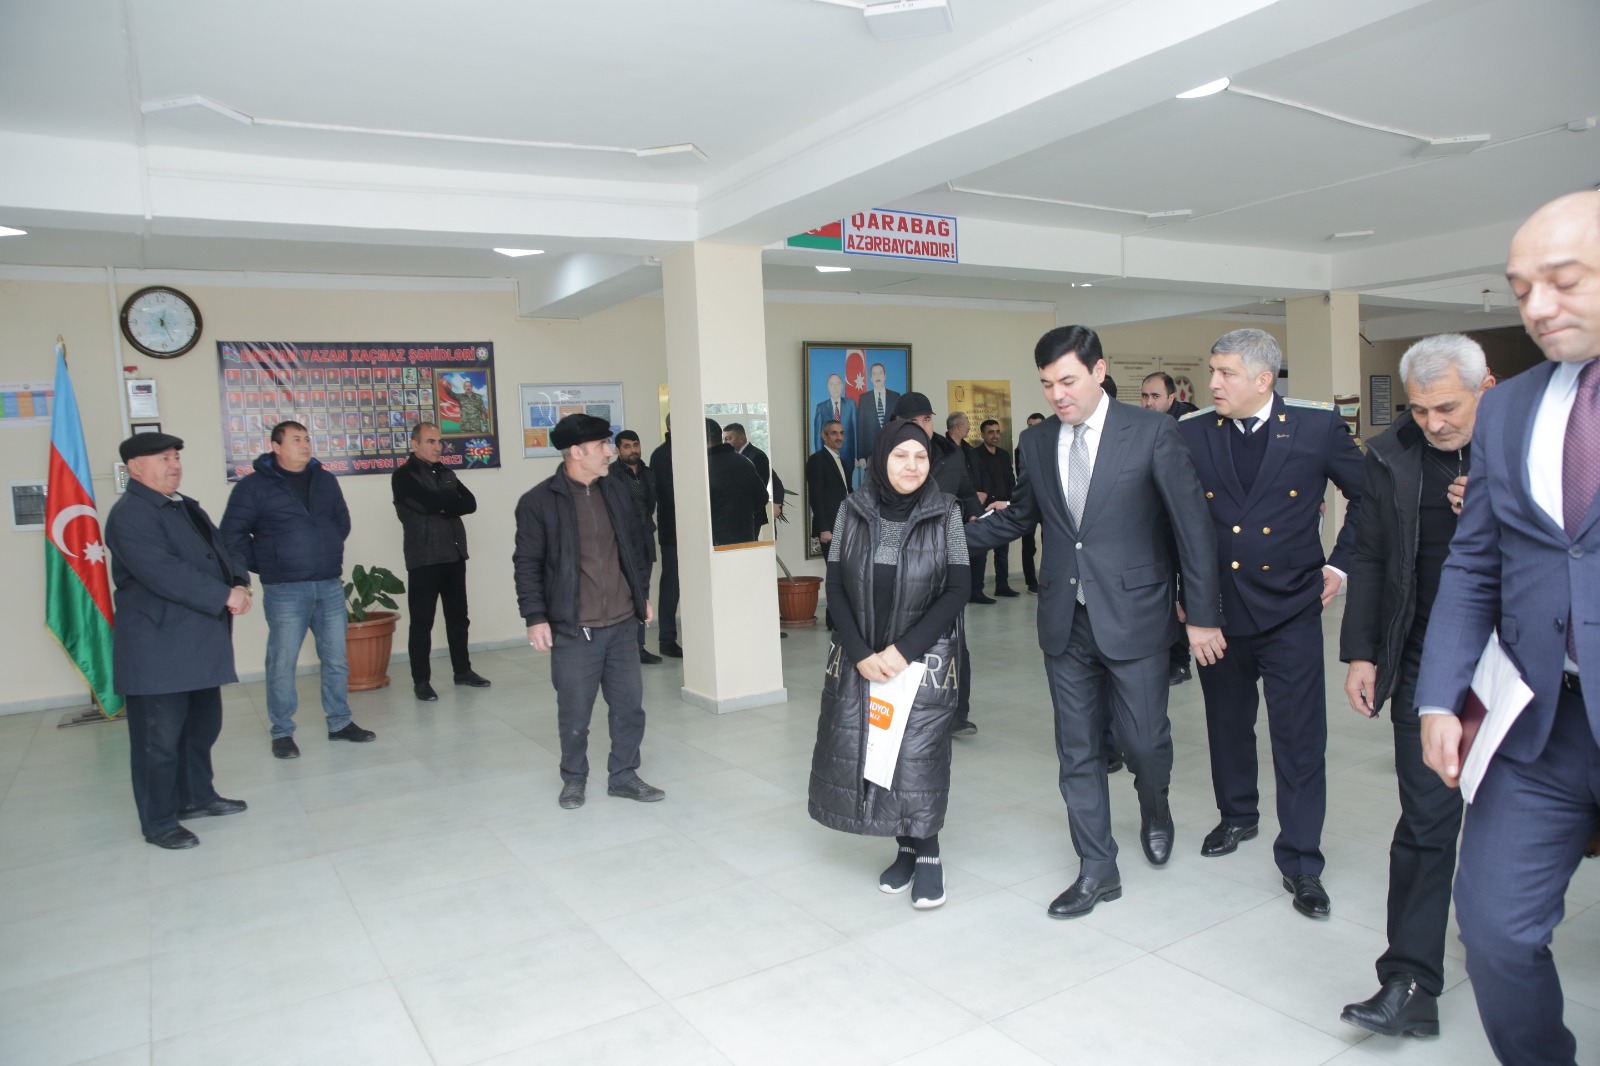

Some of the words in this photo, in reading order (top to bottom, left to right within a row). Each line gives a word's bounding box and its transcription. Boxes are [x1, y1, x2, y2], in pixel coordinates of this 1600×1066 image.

[852, 212, 950, 237] QARABAĞ
[847, 234, 955, 259] AZƏRBAYCANDIR!
[241, 349, 298, 363] DASTAN
[301, 349, 348, 363] YAZAN
[350, 348, 406, 364] XAÇMAZ
[408, 346, 476, 364] ŞƏHİDLƏRİ
[352, 458, 394, 469] VƏTƏN
